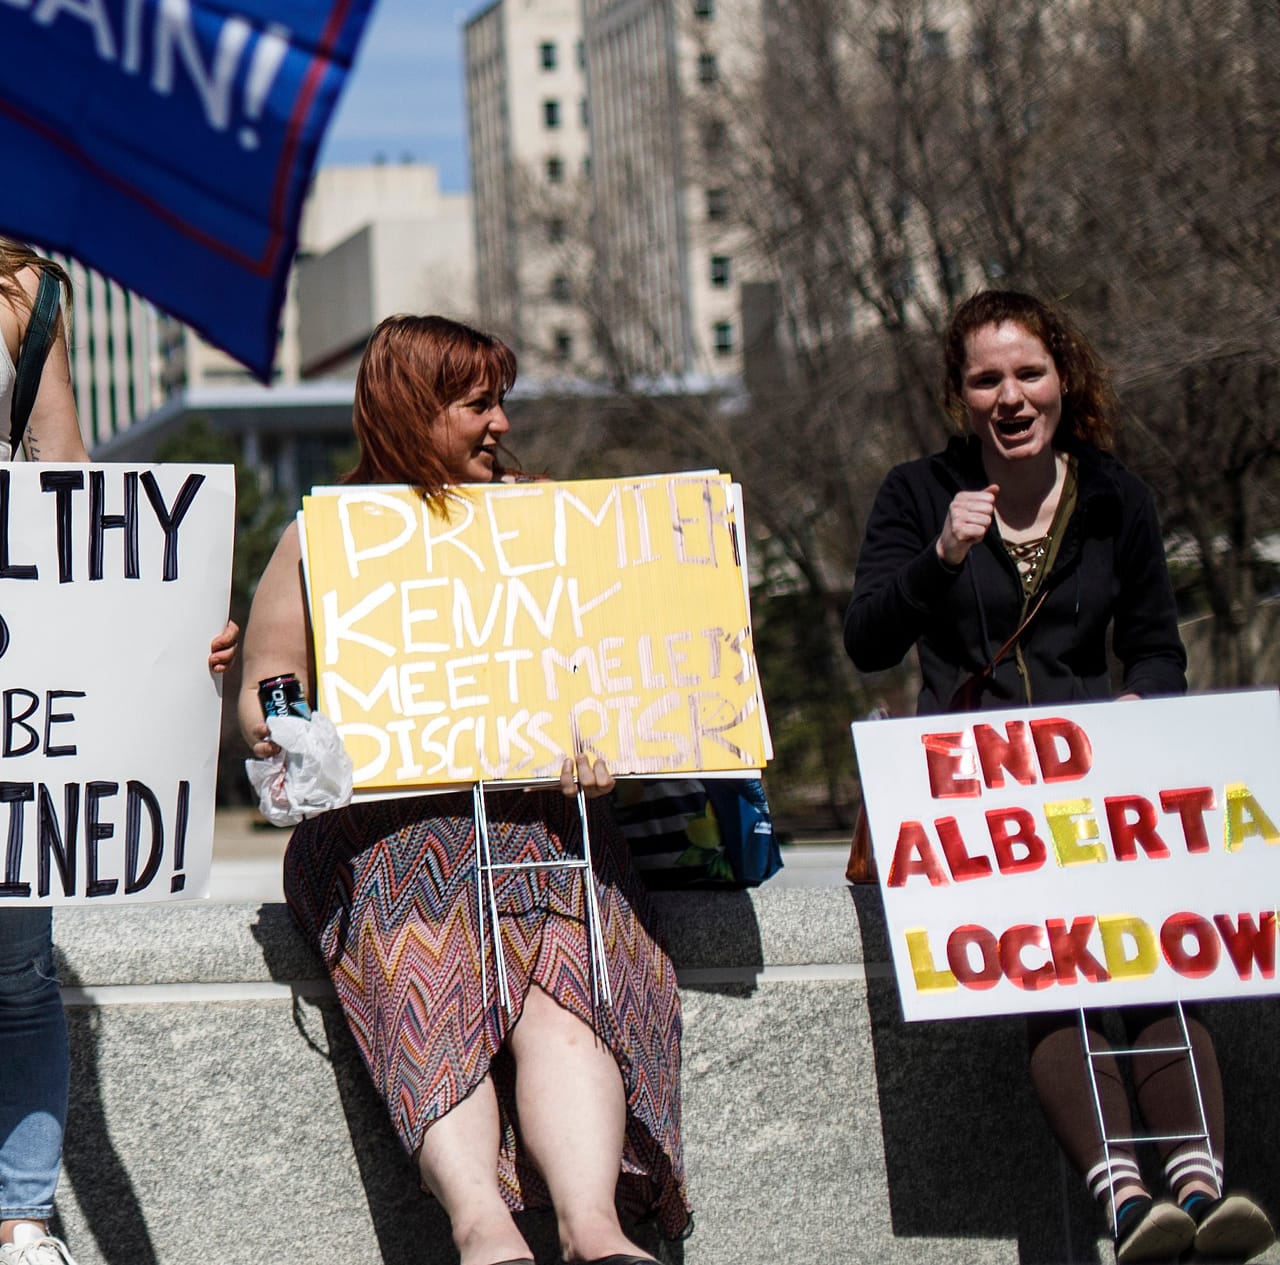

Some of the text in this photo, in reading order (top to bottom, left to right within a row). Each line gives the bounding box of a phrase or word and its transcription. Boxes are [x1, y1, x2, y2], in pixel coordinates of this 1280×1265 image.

[338, 478, 740, 578] PREMIER
[322, 575, 623, 666] KENNY
[2, 688, 87, 758] BE
[322, 649, 533, 724] MEET
[336, 690, 758, 784] DISCUSS RISK
[921, 717, 1094, 799] END
[887, 783, 1280, 888] ALBERTA
[904, 908, 1280, 995] LOCKDOW
